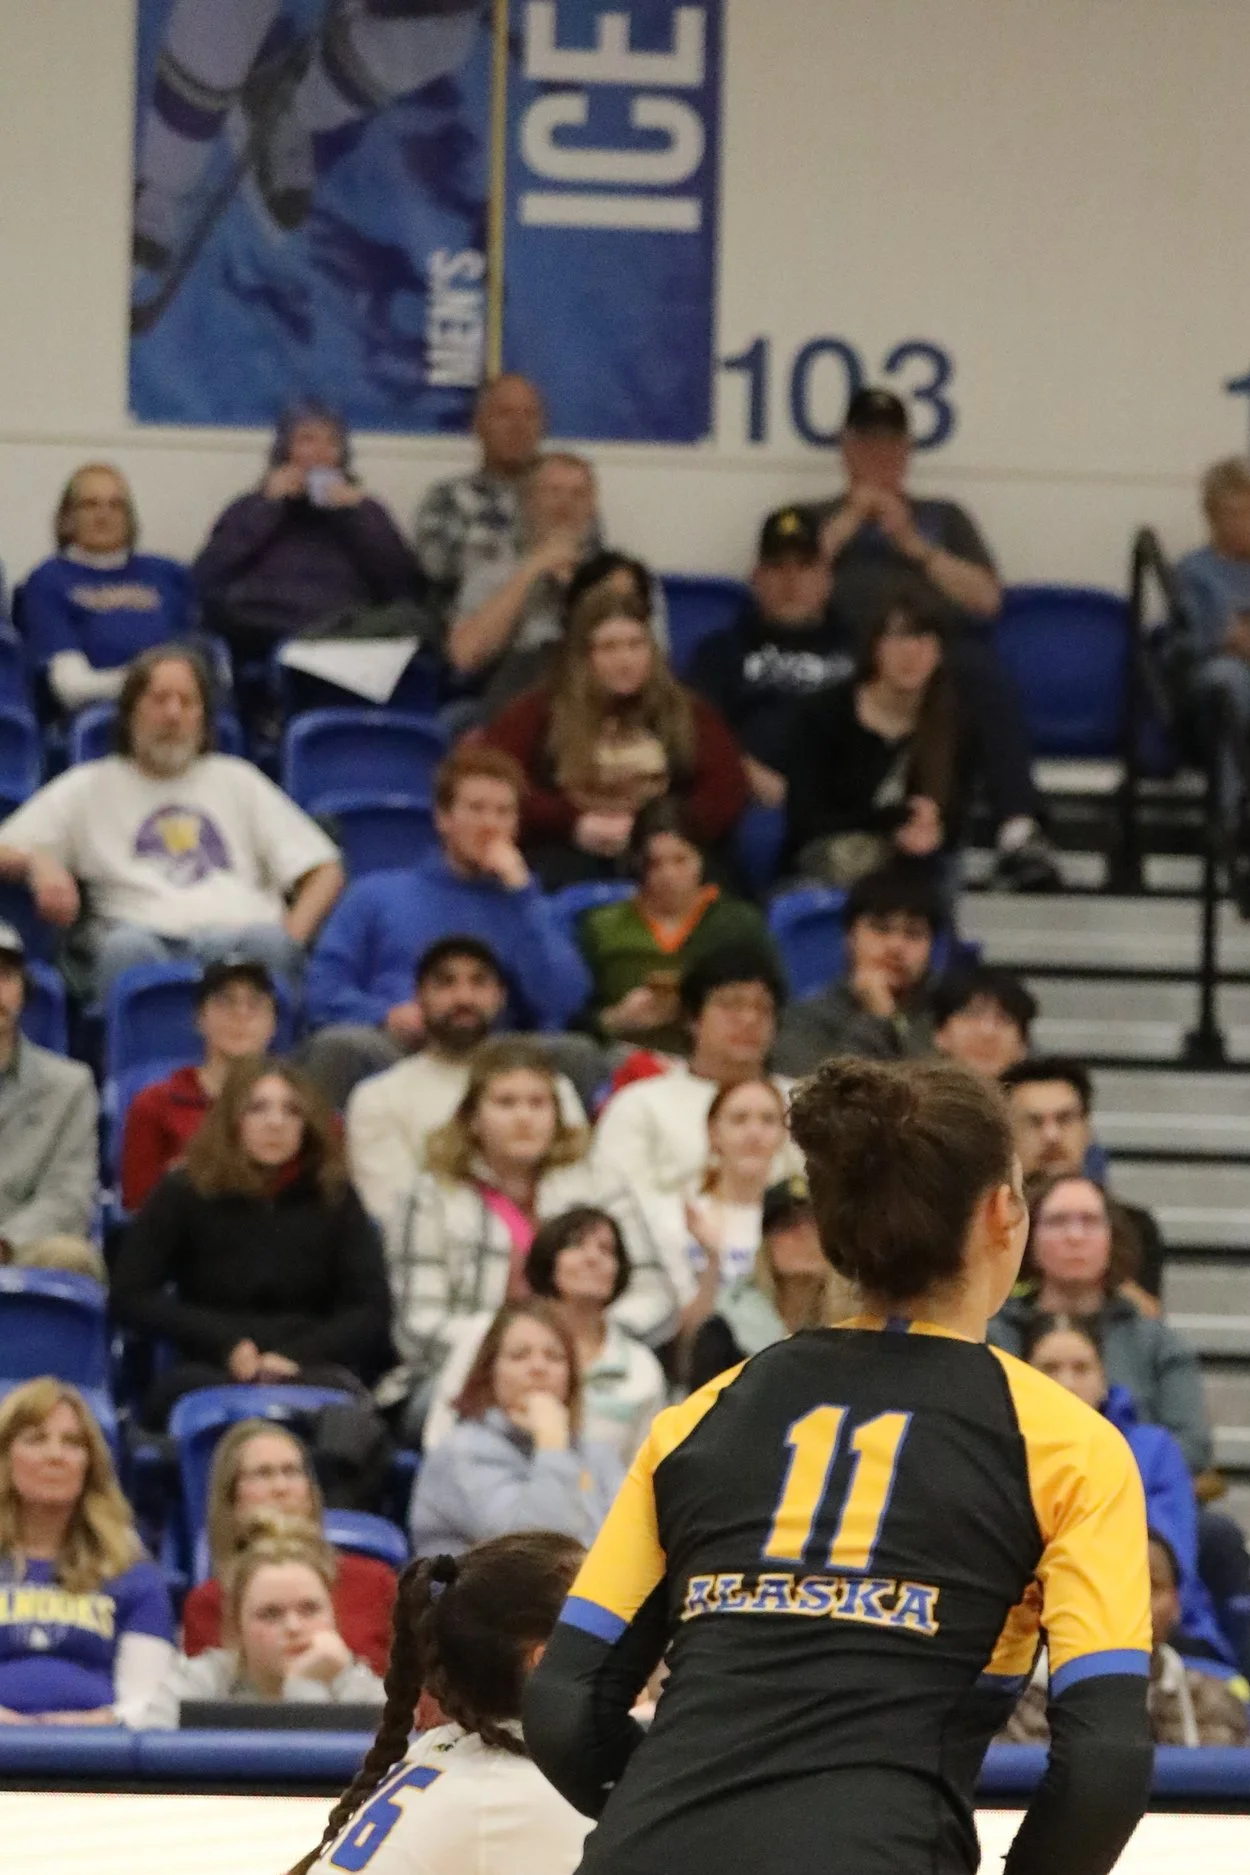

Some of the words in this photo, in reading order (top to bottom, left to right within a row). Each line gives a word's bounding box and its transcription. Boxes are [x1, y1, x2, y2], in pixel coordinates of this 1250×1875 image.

[520, 0, 706, 234] ICE
[722, 336, 957, 450] 103
[762, 1404, 913, 1572] 11
[680, 1573, 940, 1636] ALASKA
[325, 1761, 444, 1874] 6
